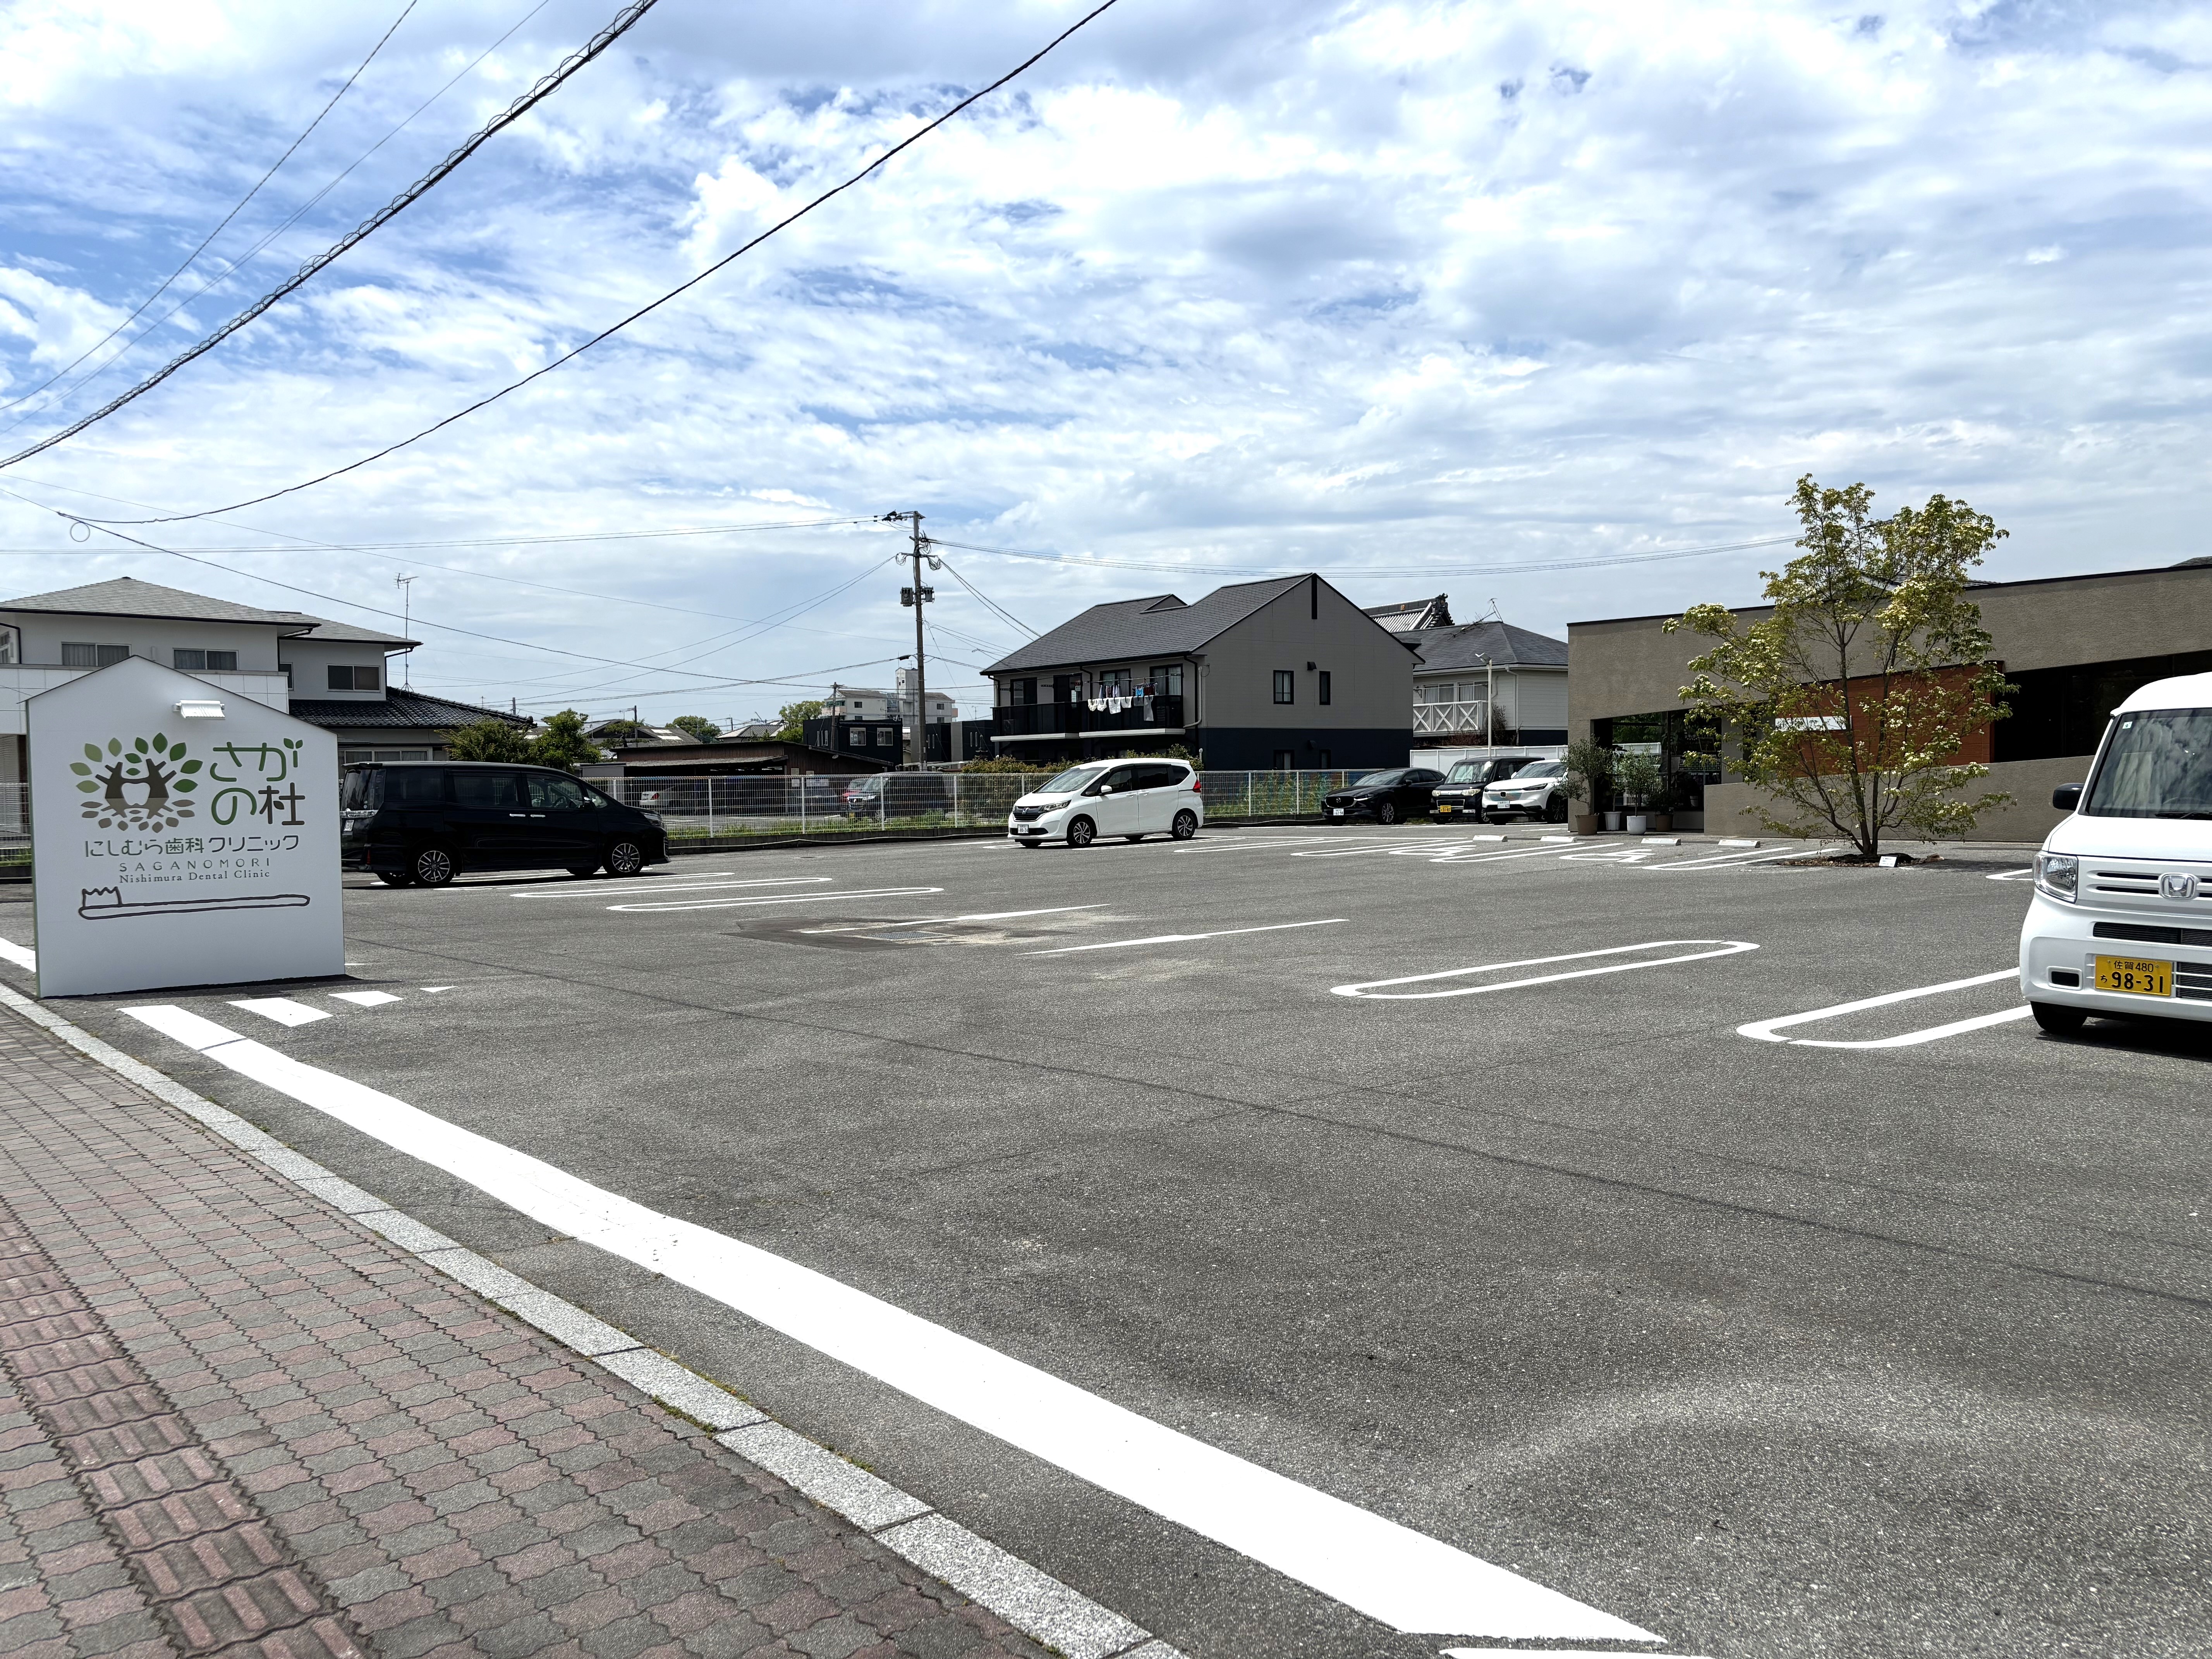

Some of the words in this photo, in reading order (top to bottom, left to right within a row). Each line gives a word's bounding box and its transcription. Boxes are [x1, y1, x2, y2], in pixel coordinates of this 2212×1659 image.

[210, 738, 303, 782] さが
[211, 782, 305, 825] の杜
[86, 835, 299, 857] にしむら歯科クリニック
[119, 858, 270, 872] SAGANOMORI
[119, 873, 182, 883] Nishimura
[189, 871, 228, 880] Dental
[234, 870, 270, 878] Clinic
[2100, 975, 2107, 983] ち
[2111, 971, 2163, 993] 98-31
